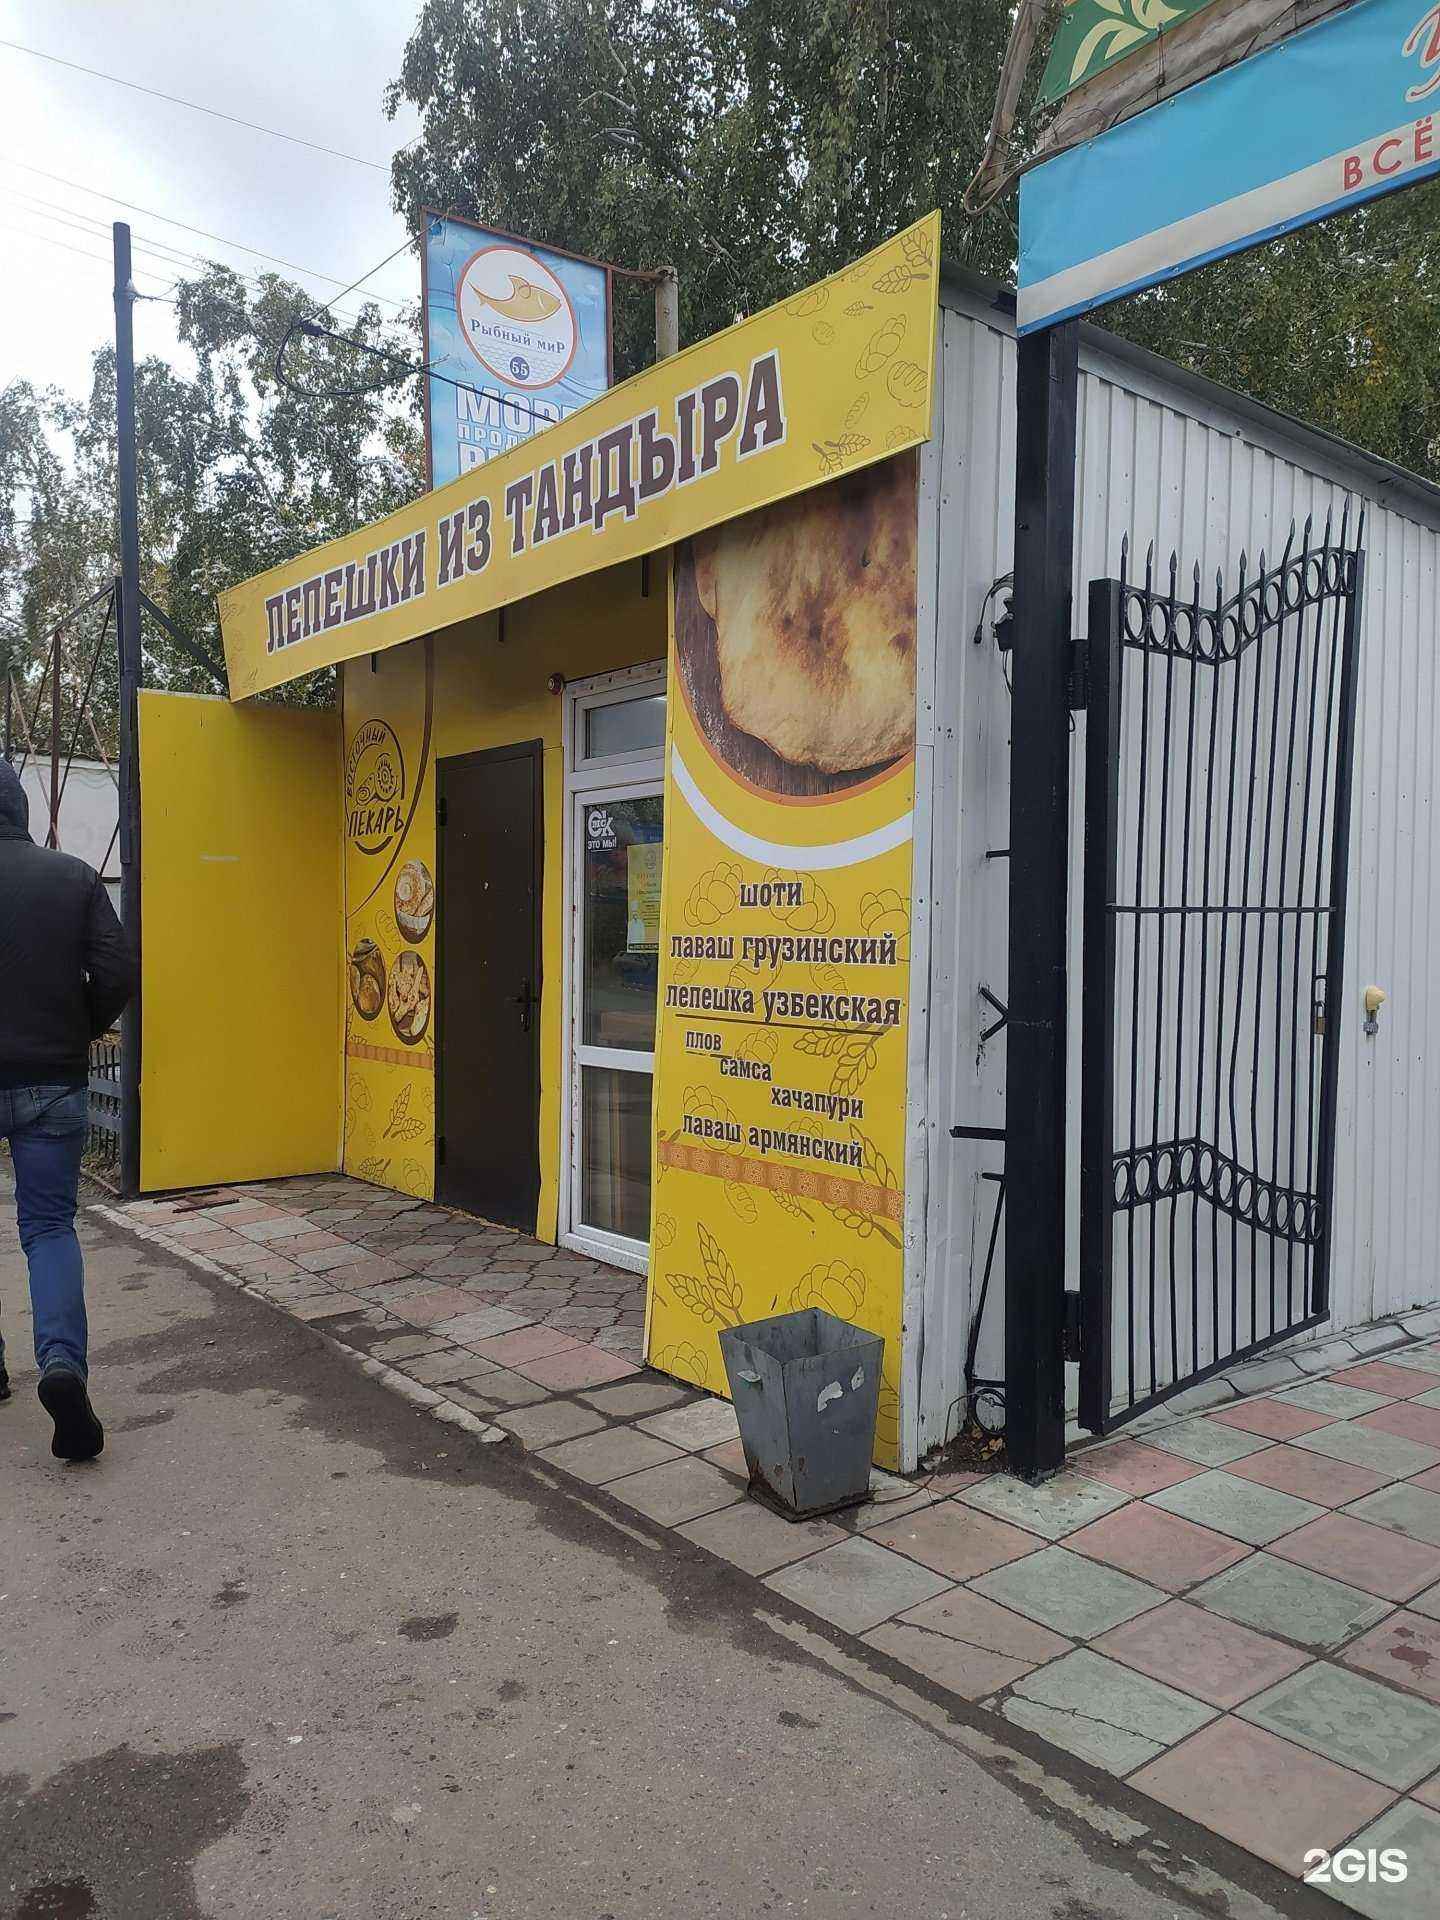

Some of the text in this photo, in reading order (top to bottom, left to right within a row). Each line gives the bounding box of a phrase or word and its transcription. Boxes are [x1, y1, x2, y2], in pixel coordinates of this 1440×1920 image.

[1344, 116, 1433, 191] ВСЁ
[471, 319, 531, 346] Рыбный
[511, 361, 528, 376] 55
[265, 348, 789, 655] ЛЕПЕШКИ ИЗ ТАНДЫРА
[346, 726, 387, 798] ВОСТОЧНЫЙ
[348, 805, 405, 838] ПЕКАРЬ
[739, 882, 803, 907] шоти
[670, 931, 898, 970] лаваш грузинский
[666, 984, 901, 1025] лепешка узбекская
[685, 1031, 722, 1051] плов
[719, 1057, 772, 1081] самса
[771, 1086, 865, 1122] хачапури
[682, 1114, 864, 1168] лаваш армянский
